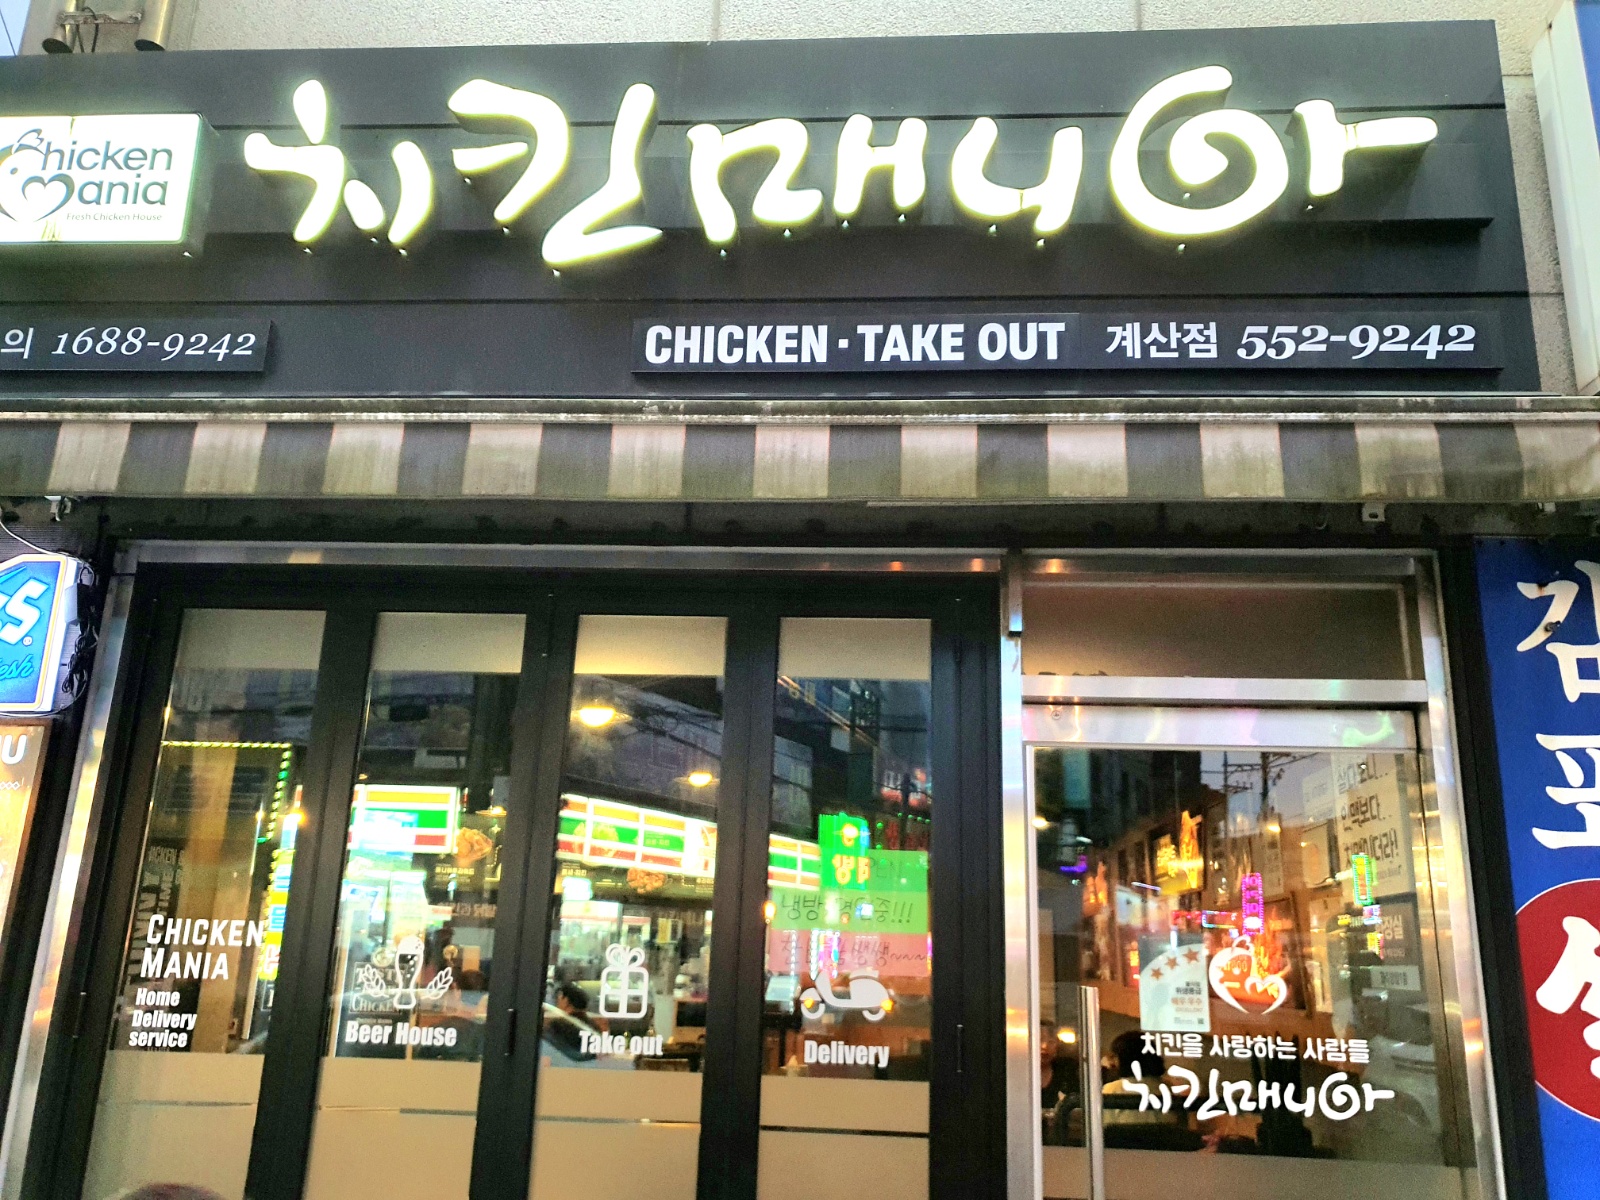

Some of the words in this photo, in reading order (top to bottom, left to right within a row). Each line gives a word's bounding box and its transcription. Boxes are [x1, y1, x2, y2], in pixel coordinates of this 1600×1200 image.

[243, 65, 1440, 268] 치킨매니아
[66, 212, 91, 221] Fresh
[93, 212, 130, 221] Chicken
[132, 212, 163, 221] House
[51, 326, 257, 361] 1688-9242
[645, 325, 828, 364] CHICKEN
[857, 323, 965, 363] TAKE
[978, 322, 1066, 362] OUT
[1106, 322, 1219, 359] 계산점
[1236, 324, 1476, 360] 552-9242
[146, 914, 264, 948] CHICKEN
[140, 947, 230, 980] MANIA
[135, 988, 181, 1007] Home
[132, 1009, 198, 1031] Delivery
[345, 1021, 392, 1044] Beer
[395, 1022, 458, 1047] House
[129, 1029, 188, 1048] service
[579, 1030, 626, 1055] Take
[629, 1033, 664, 1057] out
[803, 1039, 890, 1069] Delivery
[1140, 1032, 1203, 1058] 치킨을
[1209, 1034, 1297, 1060] 사랑하는
[1303, 1037, 1371, 1064] 사람들
[1122, 1060, 1396, 1121] 치킨매니아
